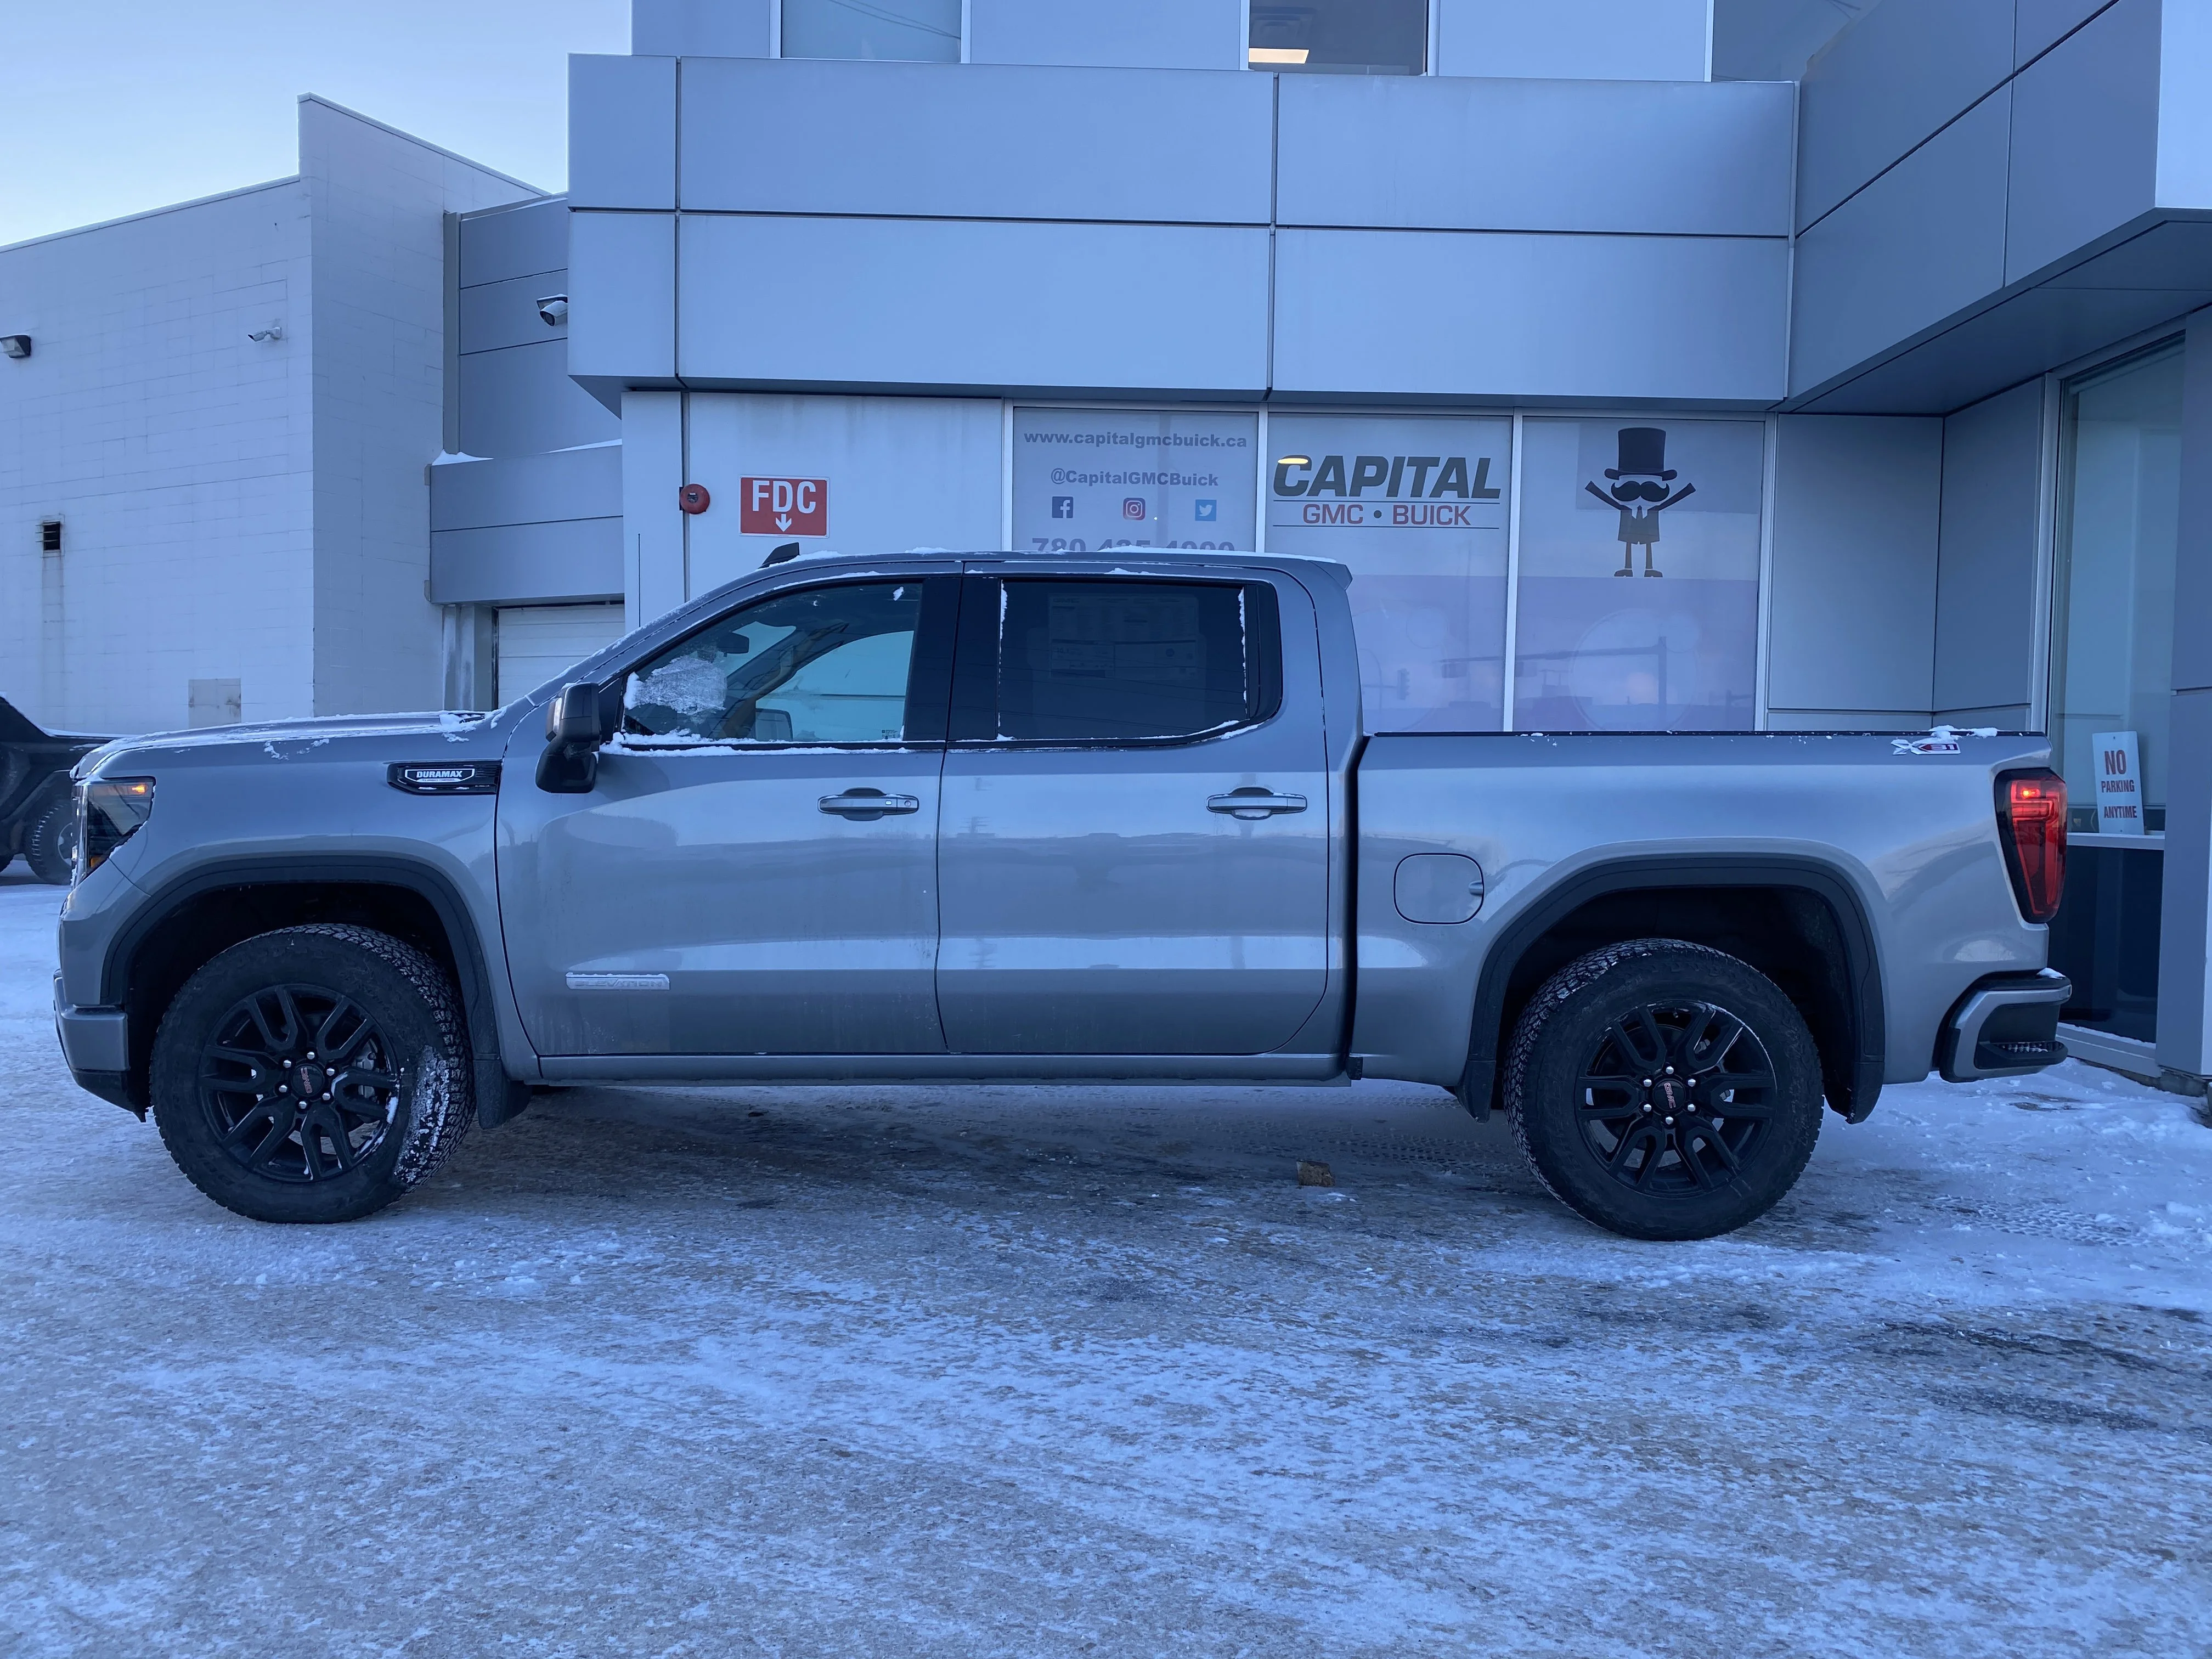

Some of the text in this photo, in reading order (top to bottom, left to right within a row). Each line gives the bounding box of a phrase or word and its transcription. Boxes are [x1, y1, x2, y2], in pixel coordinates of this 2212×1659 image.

[1024, 432, 1246, 448] www.capitalgmcbuick.ca
[1051, 468, 1218, 486] @CapitalGMCBuick
[1273, 455, 1501, 498] CAPITAL
[752, 480, 816, 514] FDC
[1303, 504, 1471, 525] GMC BUICK
[2104, 750, 2126, 775] NO
[2101, 780, 2135, 793] PARKING
[2104, 806, 2137, 818] ANYTIME
[301, 1067, 312, 1093] GMC
[1664, 1082, 1676, 1108] GMC
